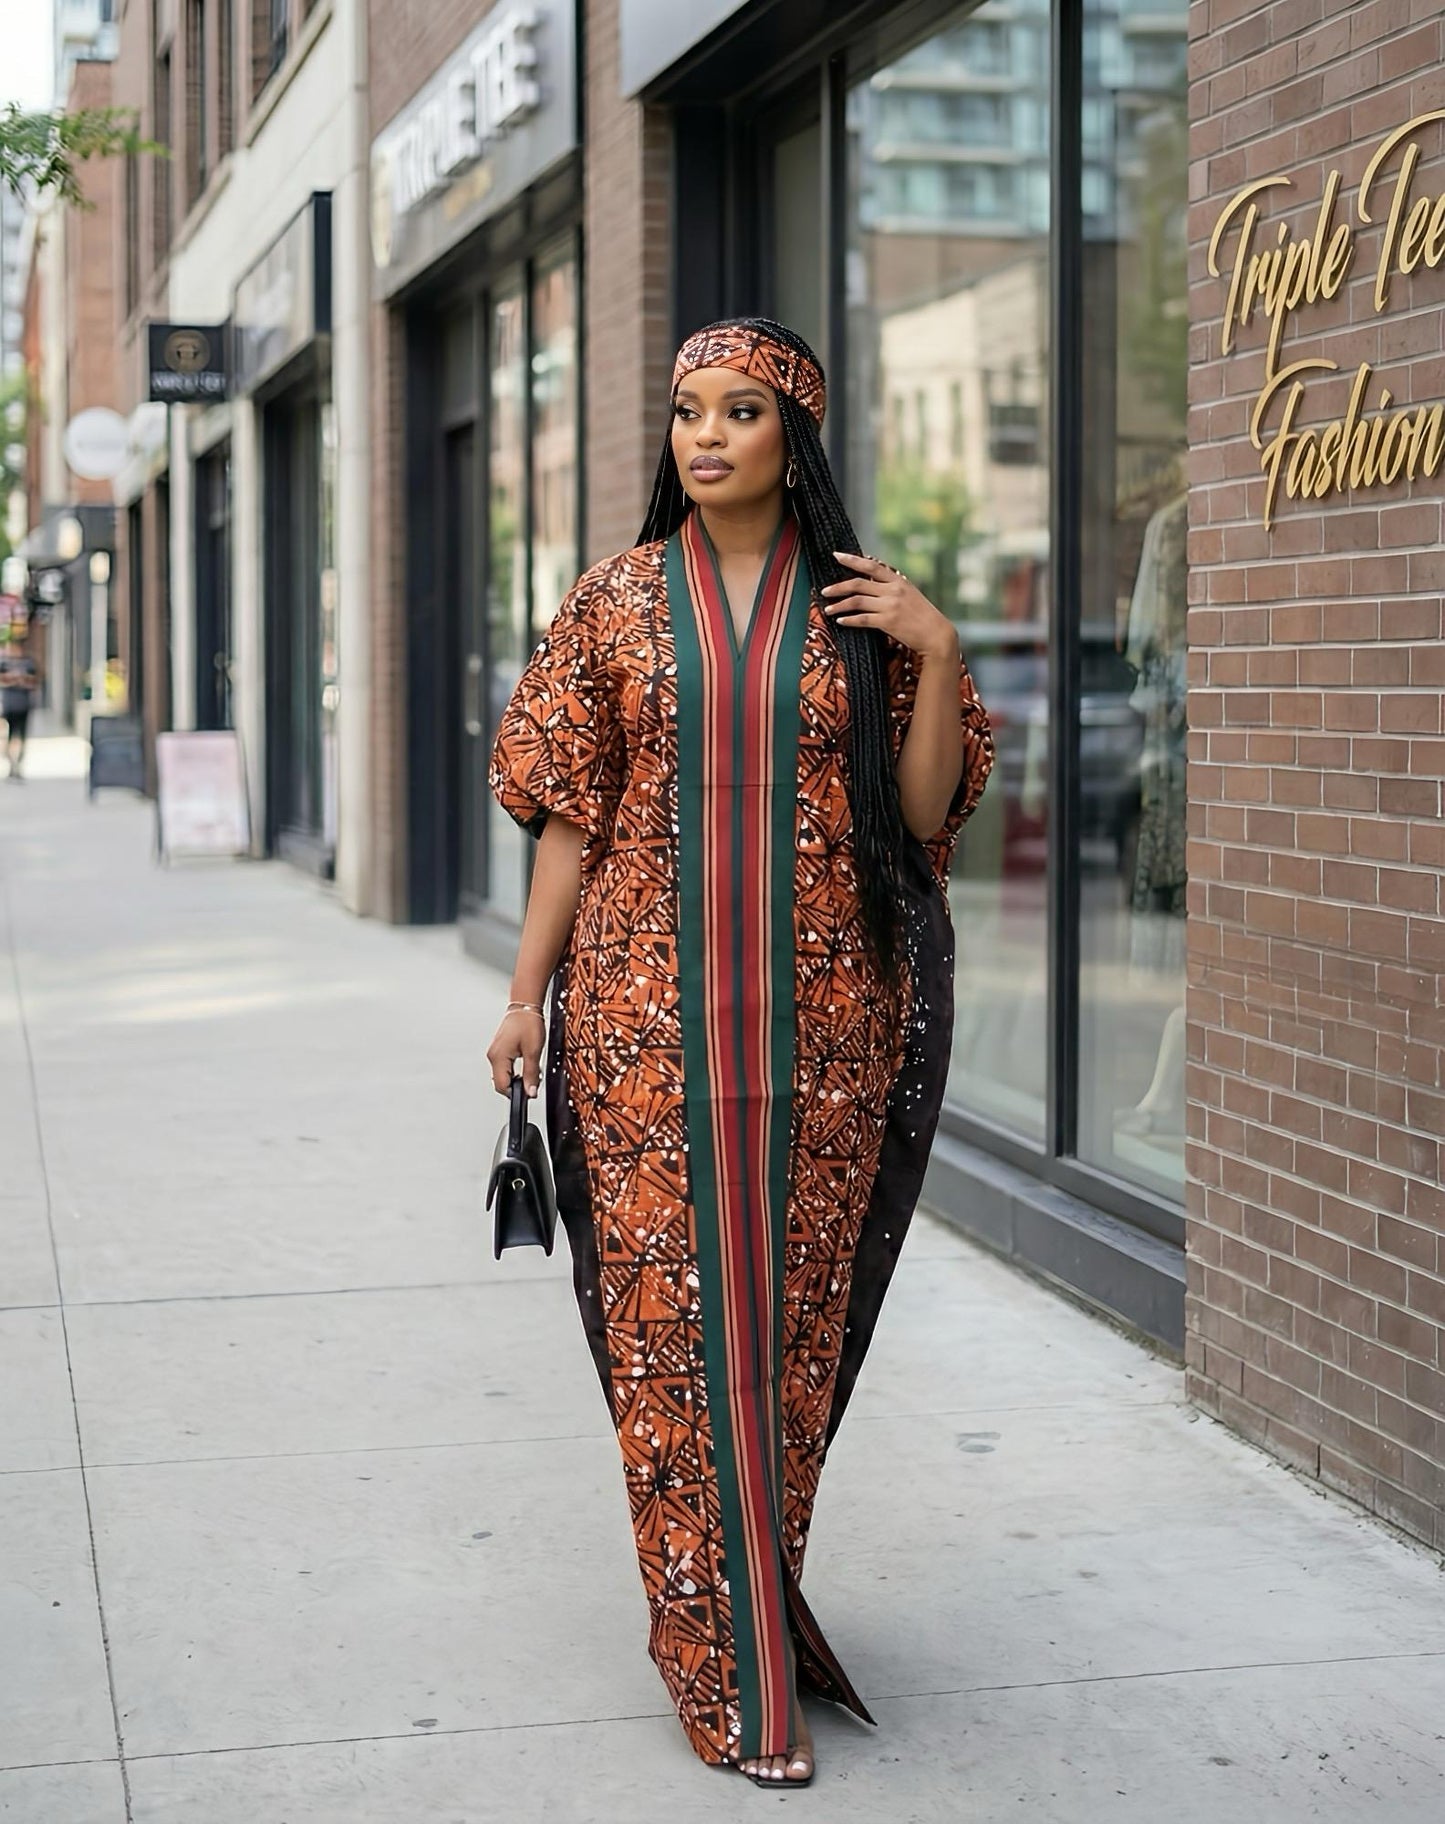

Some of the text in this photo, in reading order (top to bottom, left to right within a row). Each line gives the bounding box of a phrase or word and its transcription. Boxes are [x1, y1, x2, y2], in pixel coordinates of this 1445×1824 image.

[1207, 109, 1445, 382] Triple Tee
[1250, 358, 1445, 531] Fashion
